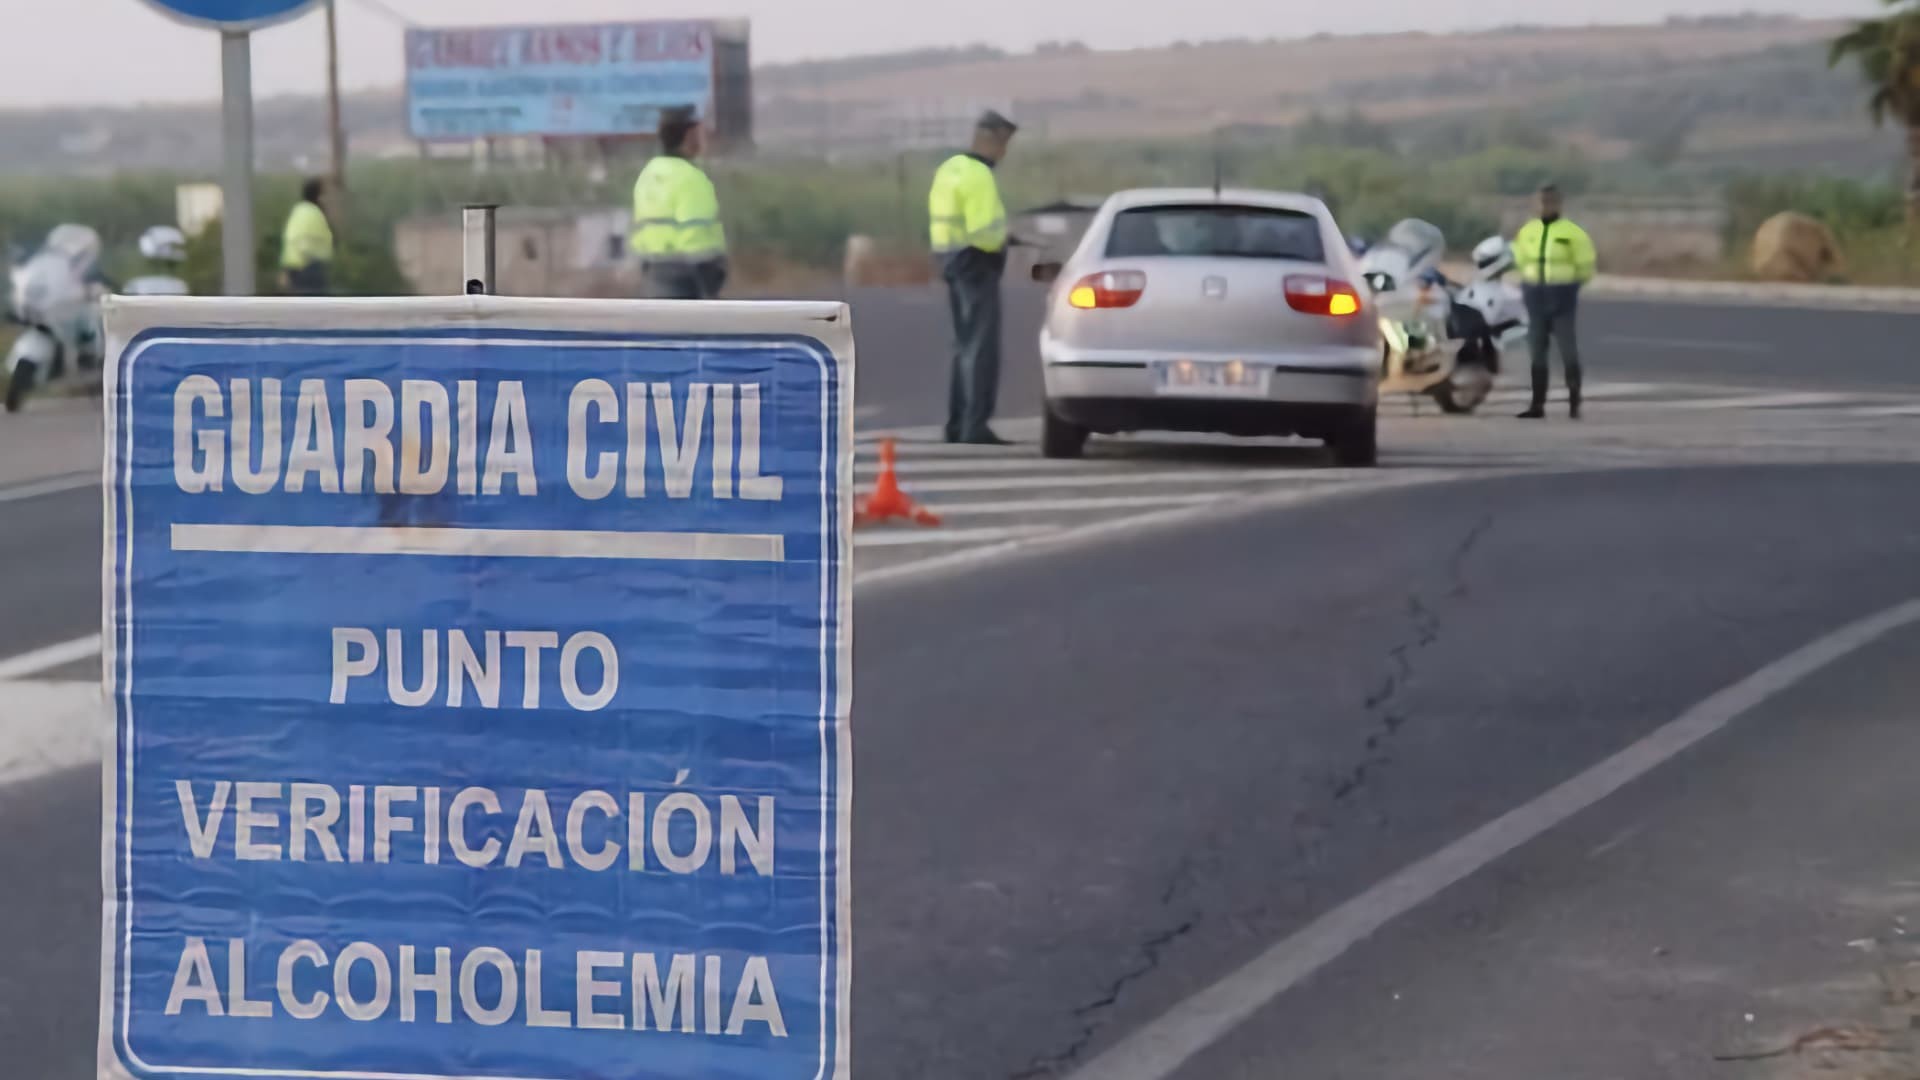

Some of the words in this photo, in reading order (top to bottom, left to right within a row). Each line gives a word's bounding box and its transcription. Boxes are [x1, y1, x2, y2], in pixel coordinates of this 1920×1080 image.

[173, 374, 538, 496] GUARDIA
[566, 378, 784, 501] CIVIL
[329, 627, 619, 712] PUNTO
[175, 769, 775, 876] VERIFICACIÓN
[164, 936, 788, 1038] ALCOHOLEMIA
